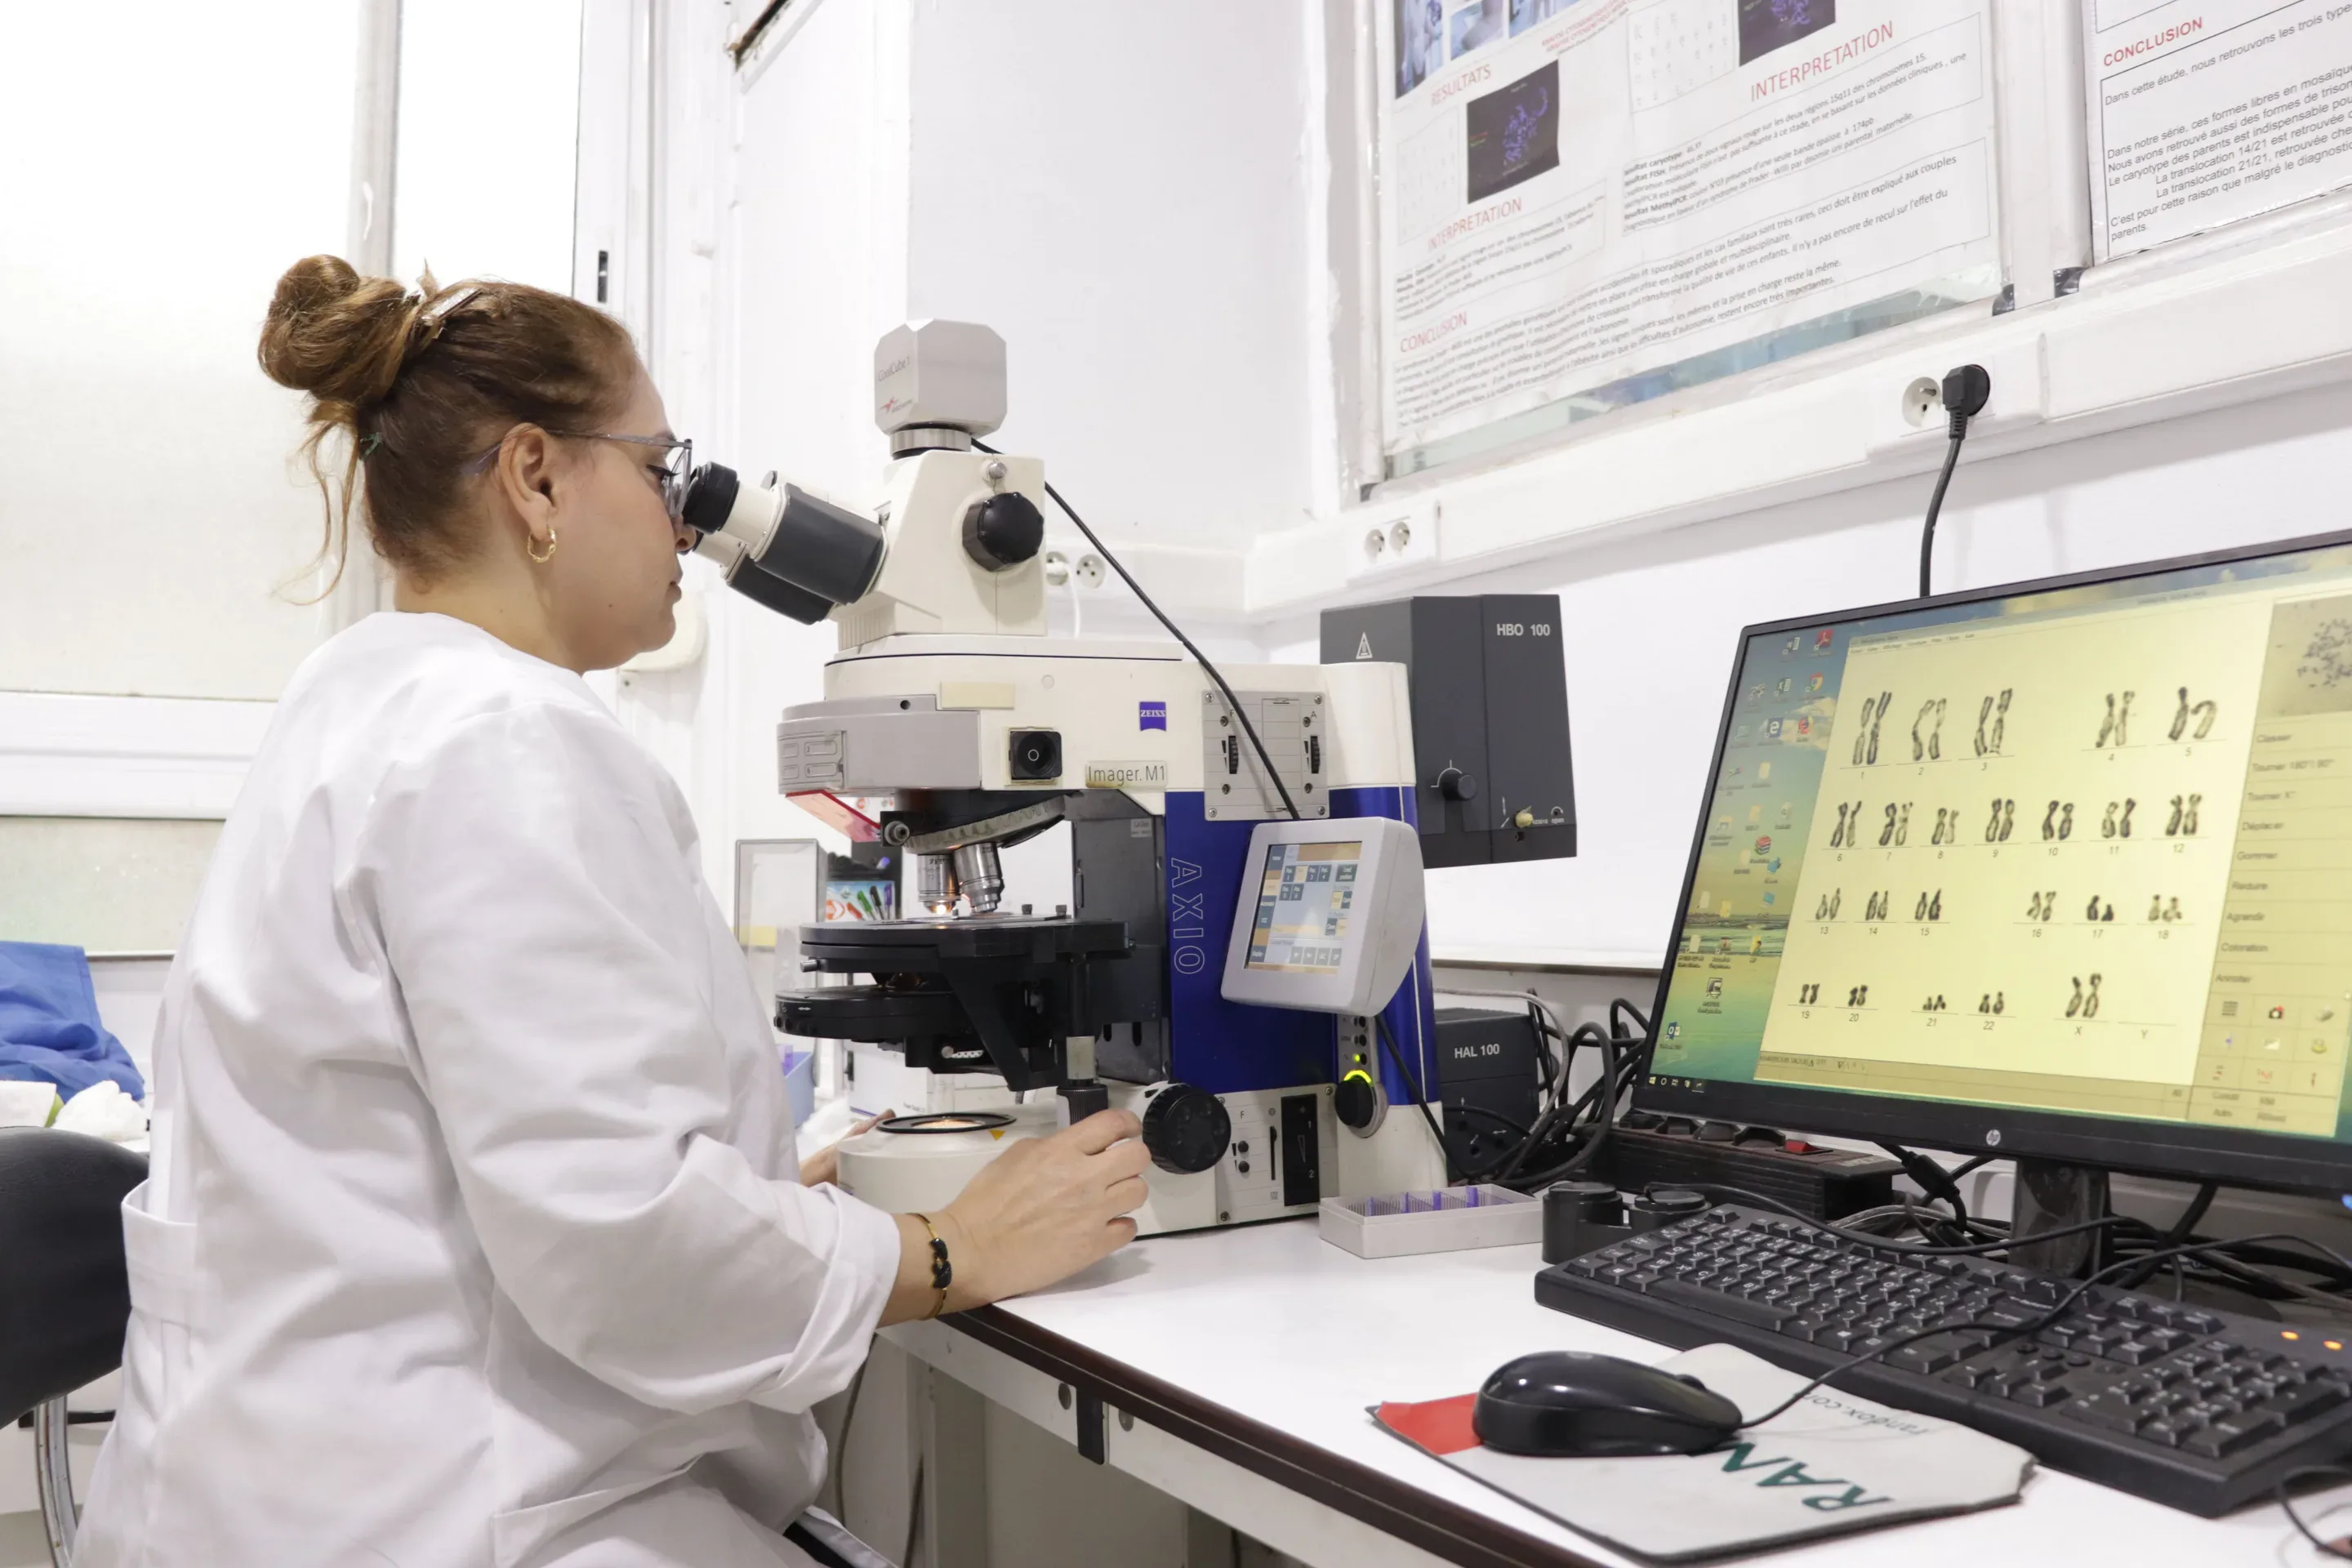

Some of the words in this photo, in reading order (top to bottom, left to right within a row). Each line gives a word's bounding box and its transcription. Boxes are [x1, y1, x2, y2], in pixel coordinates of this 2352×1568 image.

[1751, 20, 1893, 102] INTERPRETATION
[2104, 16, 2202, 66] CONCLUSION
[2105, 91, 2130, 106] Dans
[2131, 81, 2156, 96] cette
[2191, 56, 2216, 73] nous
[2218, 33, 2276, 62] retrouvons
[2278, 25, 2296, 38] les
[2297, 15, 2323, 31] trois
[1430, 63, 1492, 107] RESULTATS
[2107, 145, 2132, 159] Dans
[2134, 135, 2159, 149] notre
[2191, 117, 2210, 130] ces
[2212, 103, 2248, 122] formes
[2251, 91, 2281, 109] libres
[2283, 85, 2297, 96] en
[2108, 158, 2133, 173] Nous
[2135, 148, 2164, 164] avons
[2166, 131, 2207, 153] retrouvé
[2210, 119, 2238, 138] aussi
[2239, 114, 2261, 127] des
[2262, 99, 2301, 119] formes
[2303, 92, 2319, 105] de
[1920, 156, 1958, 174] couples
[2109, 176, 2121, 187] Le
[2172, 153, 2190, 165] des
[2192, 138, 2232, 161] parents
[2234, 130, 2251, 144] est
[2252, 104, 2330, 137] indispensable
[2155, 174, 2168, 185] La
[2170, 151, 2235, 180] translocation
[2238, 138, 2267, 156] 14/21
[2270, 131, 2287, 145] est
[1935, 189, 1949, 200] du
[2136, 205, 2159, 221] pour
[2161, 197, 2185, 212] cette
[2187, 185, 2219, 203] raison
[2221, 179, 2242, 193] que
[2243, 163, 2282, 184] malgré
[2284, 161, 2294, 171] le
[2156, 188, 2169, 198] La
[2170, 166, 2236, 194] translocation
[1497, 623, 1524, 636] HBO
[1530, 624, 1551, 636] 100
[1139, 710, 1166, 718] ZEISS
[1170, 858, 1205, 974] AXIO
[1820, 926, 1829, 934] 13
[1869, 927, 1878, 935] 14
[1920, 928, 1930, 936] 15
[2032, 929, 2042, 938] 16
[2092, 929, 2104, 938] 17
[2158, 930, 2169, 939] 18
[1849, 1013, 1859, 1022] 20
[1927, 1018, 1937, 1027] 21
[1983, 1021, 1994, 1030] 22
[2074, 1027, 2082, 1036] X
[2141, 1029, 2148, 1039] Y
[1454, 1045, 1478, 1059] HAL
[1480, 1044, 1500, 1057] 100
[1241, 1111, 1245, 1119] F
